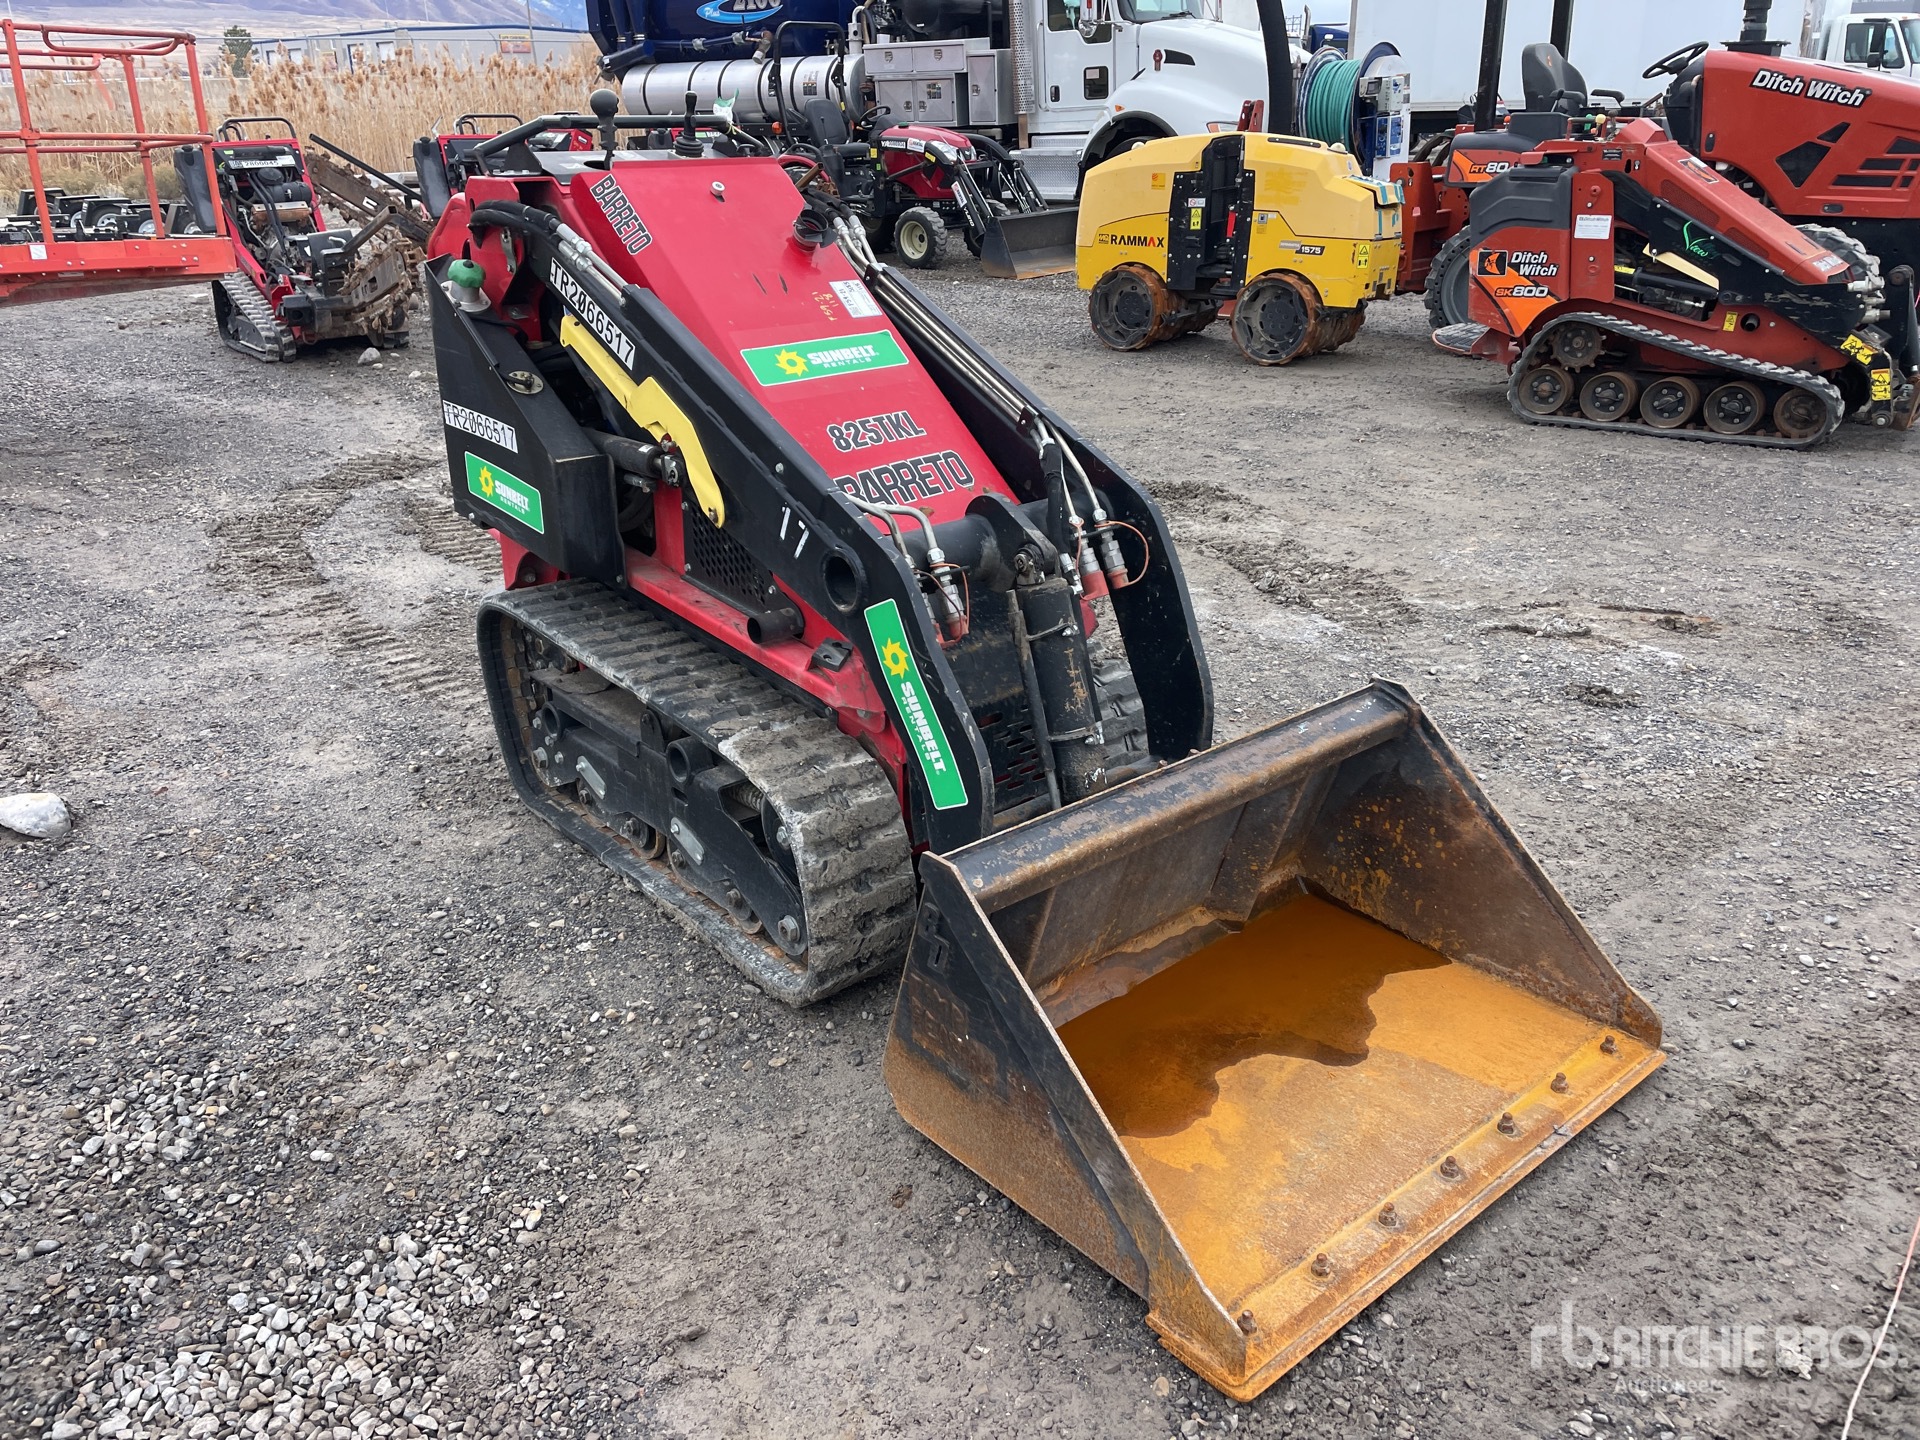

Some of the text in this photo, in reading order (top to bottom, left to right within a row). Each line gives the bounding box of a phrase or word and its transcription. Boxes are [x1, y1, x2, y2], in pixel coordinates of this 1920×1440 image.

[1751, 69, 1865, 109] Ditch Witch
[590, 174, 653, 255] BARRETO
[1110, 234, 1165, 248] RAMMAX
[1301, 246, 1321, 254] 1575
[1511, 252, 1549, 264] Ditch
[1519, 264, 1558, 277] Witch
[1495, 286, 1549, 298] SK800
[551, 260, 634, 366] TR2066517
[807, 345, 876, 365] SUNBELT
[823, 357, 871, 369] RENTALS
[444, 403, 516, 452] TR2066517
[827, 410, 926, 452] 825TKL
[833, 450, 975, 506] BARRETO
[494, 479, 530, 510] SUNBELT
[500, 496, 526, 515] RENTALS
[900, 681, 946, 773] SUNBELT
[902, 696, 931, 761] RENTALS
